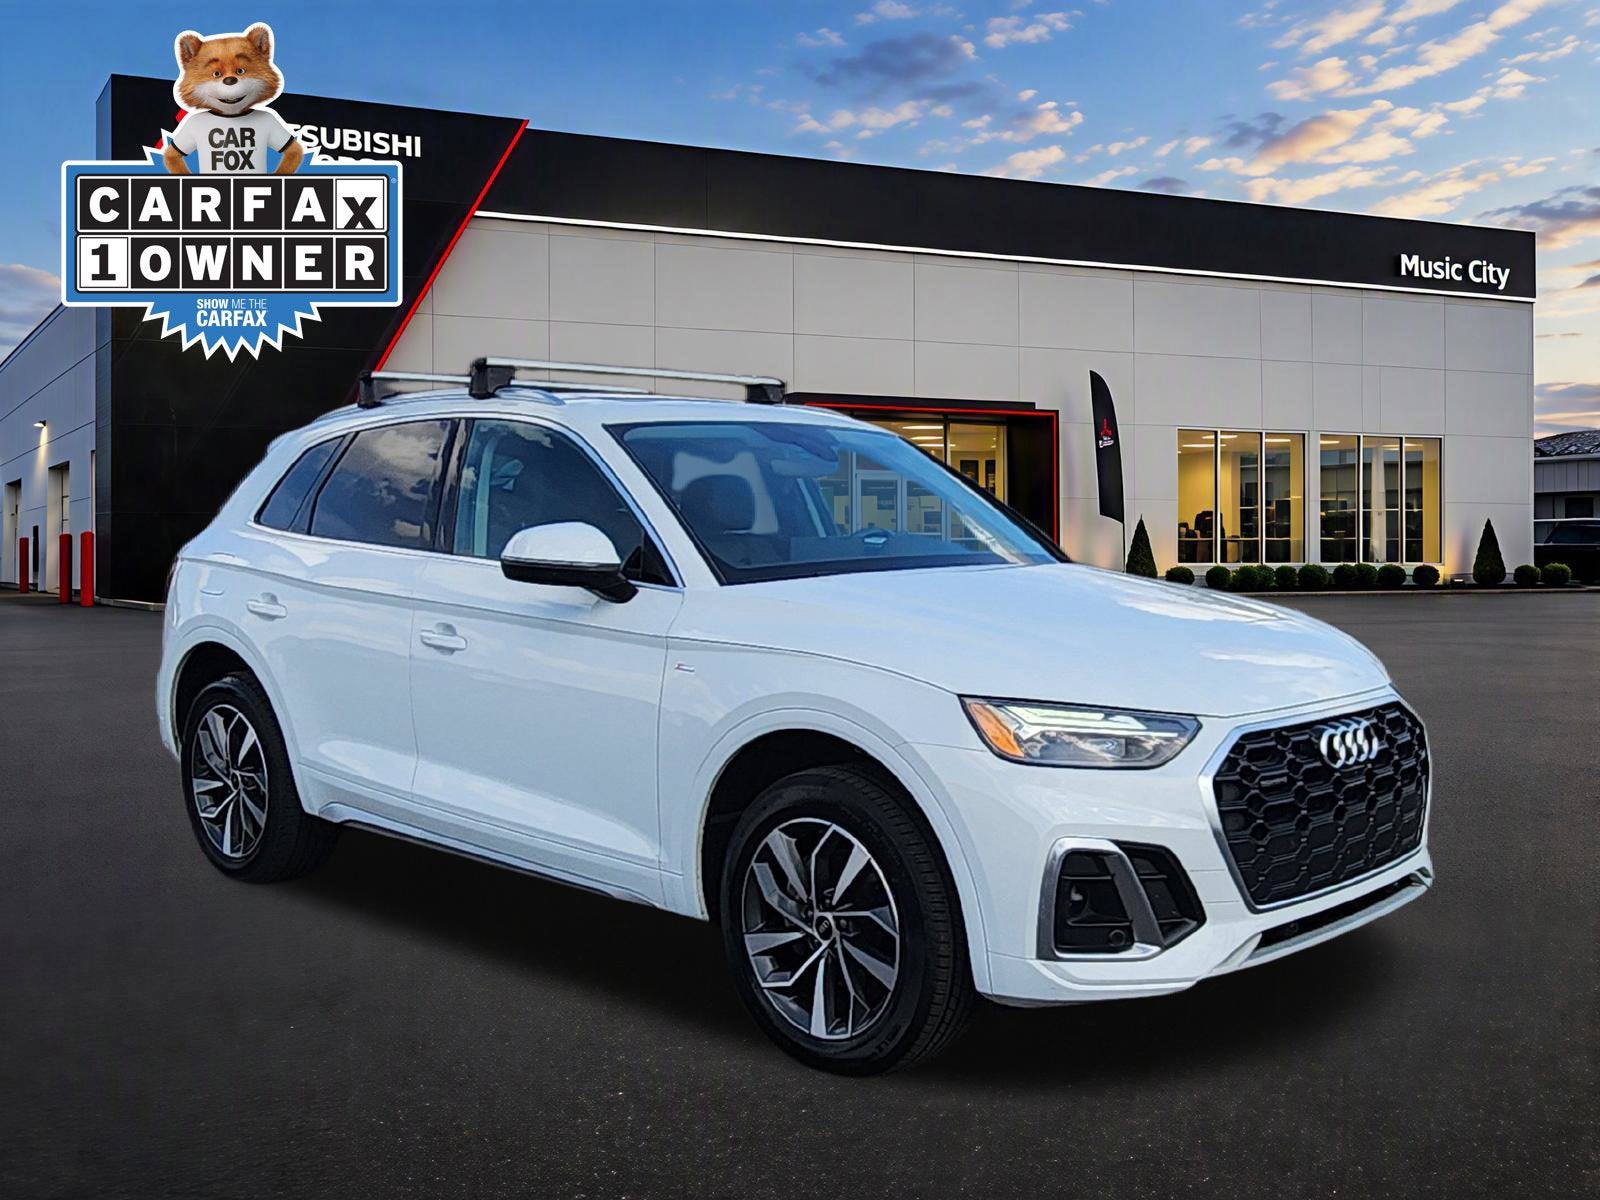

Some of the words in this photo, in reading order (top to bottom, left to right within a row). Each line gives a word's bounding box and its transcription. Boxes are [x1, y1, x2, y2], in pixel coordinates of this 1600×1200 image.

[287, 123, 421, 157] SUBISHI
[1400, 253, 1463, 281] Music
[1468, 259, 1511, 290] City
